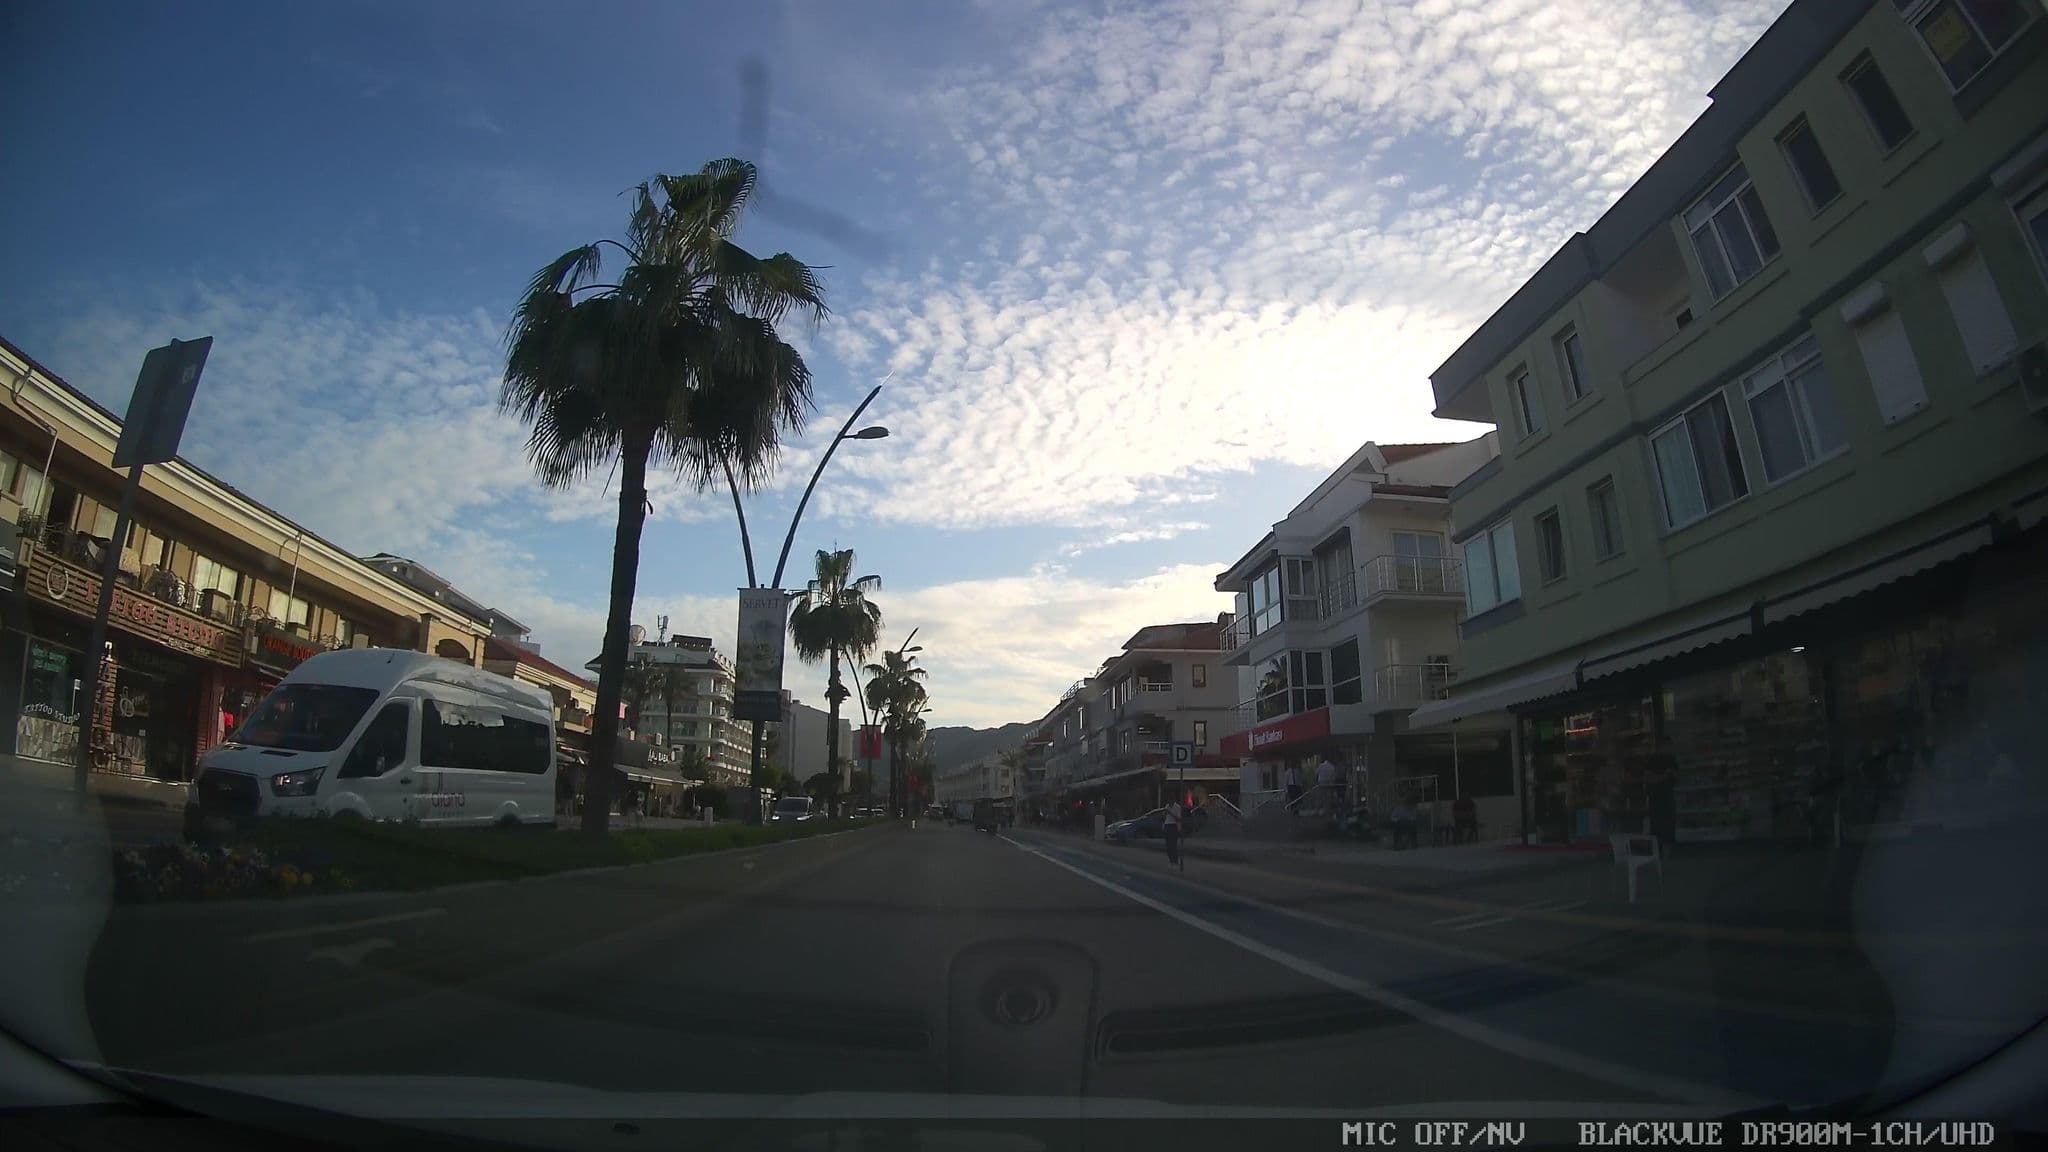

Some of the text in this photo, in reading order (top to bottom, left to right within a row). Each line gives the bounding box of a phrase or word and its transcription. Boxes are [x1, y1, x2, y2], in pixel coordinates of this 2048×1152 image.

[84, 580, 225, 651] TTTOO STUDIO
[24, 702, 53, 715] TATTOO
[1176, 747, 1188, 762] D
